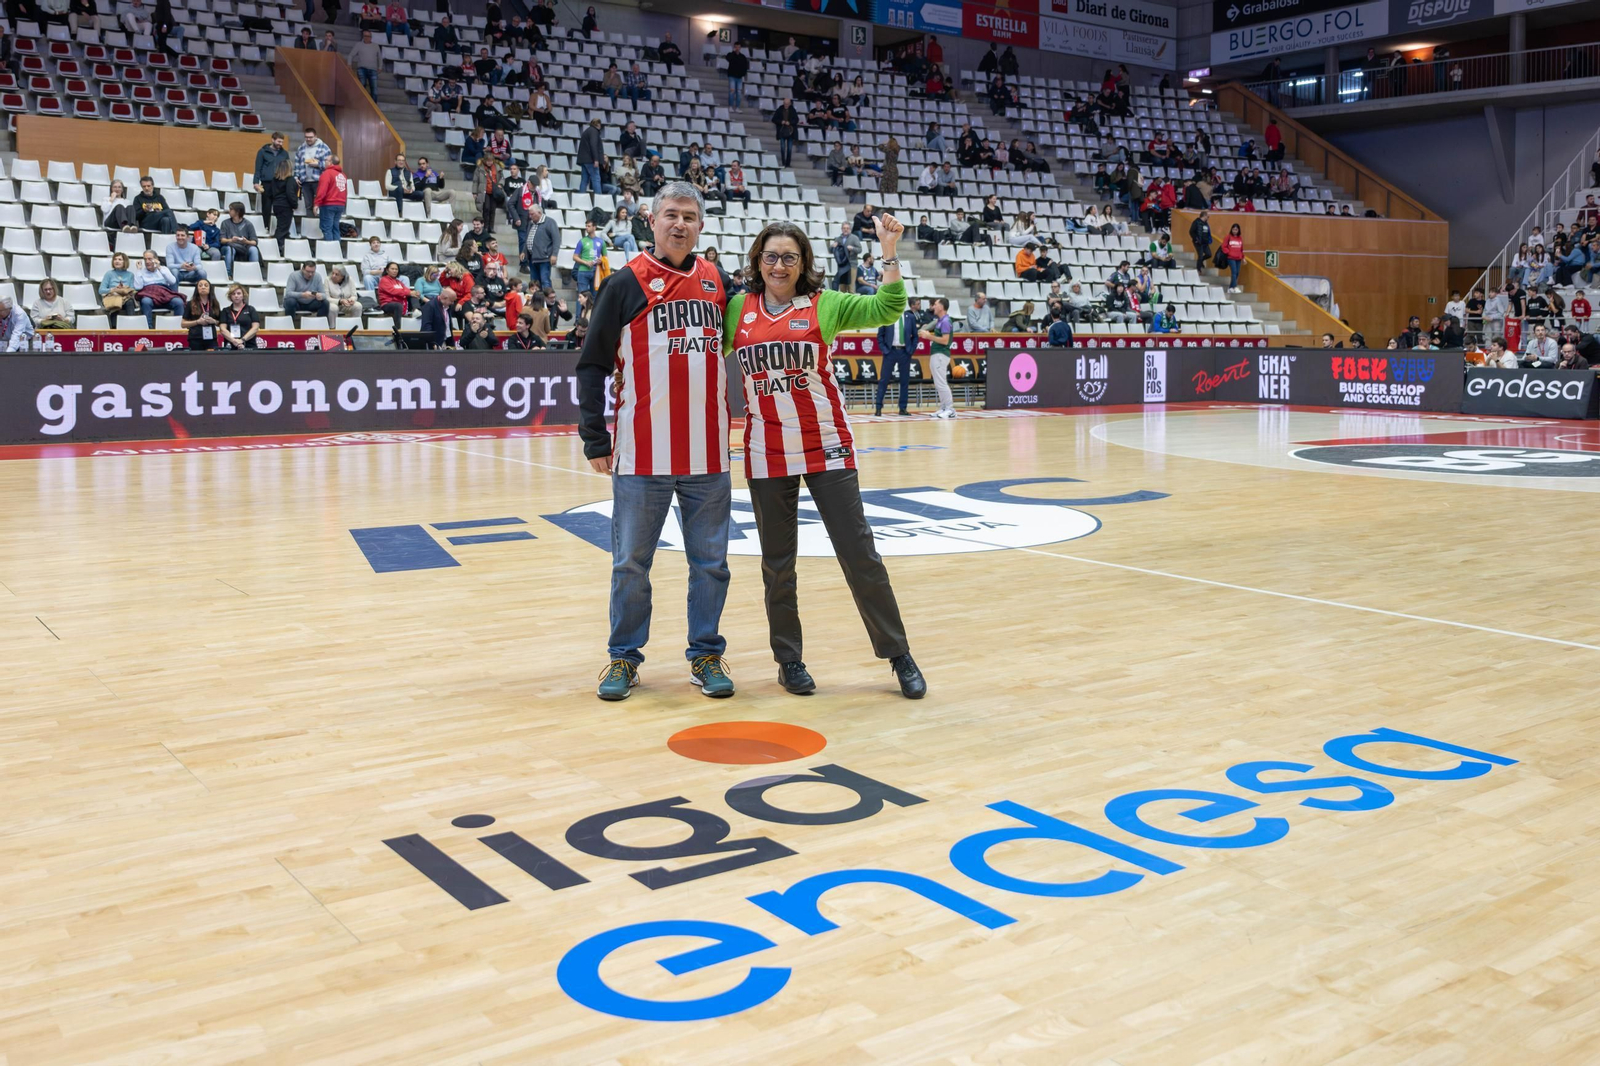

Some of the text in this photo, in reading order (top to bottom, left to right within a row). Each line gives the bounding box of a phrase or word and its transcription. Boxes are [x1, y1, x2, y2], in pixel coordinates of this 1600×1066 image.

[1076, 0, 1169, 29] Diari de Girona
[1408, 0, 1470, 20] DISPUIG
[976, 13, 1028, 34] ESTRELLA
[1043, 20, 1108, 43] VILA FOODS
[1229, 8, 1364, 51] BUERGO.FOL
[1285, 41, 1311, 51] QUALITY
[1318, 36, 1335, 45] YOUR
[1337, 31, 1364, 42] SUCCESS
[652, 299, 723, 334] GIRONA
[104, 342, 123, 352] BG
[278, 341, 295, 350] BG
[843, 341, 855, 350] BG
[737, 341, 816, 377] GIRONA
[1076, 354, 1108, 380] El Tall
[1146, 354, 1154, 367] SI
[1331, 356, 1436, 382] FOCK VIU
[1146, 367, 1157, 380] NO
[753, 373, 811, 397] FIATC
[1146, 380, 1162, 394] FOS
[1258, 375, 1291, 400] NER
[1339, 382, 1426, 397] BURGER SHOP
[1467, 373, 1585, 401] endesa
[1008, 394, 1038, 407] porcus
[1343, 393, 1421, 406] AND COCKTAILS
[382, 763, 930, 911] liga
[557, 727, 1519, 1022] endesa
